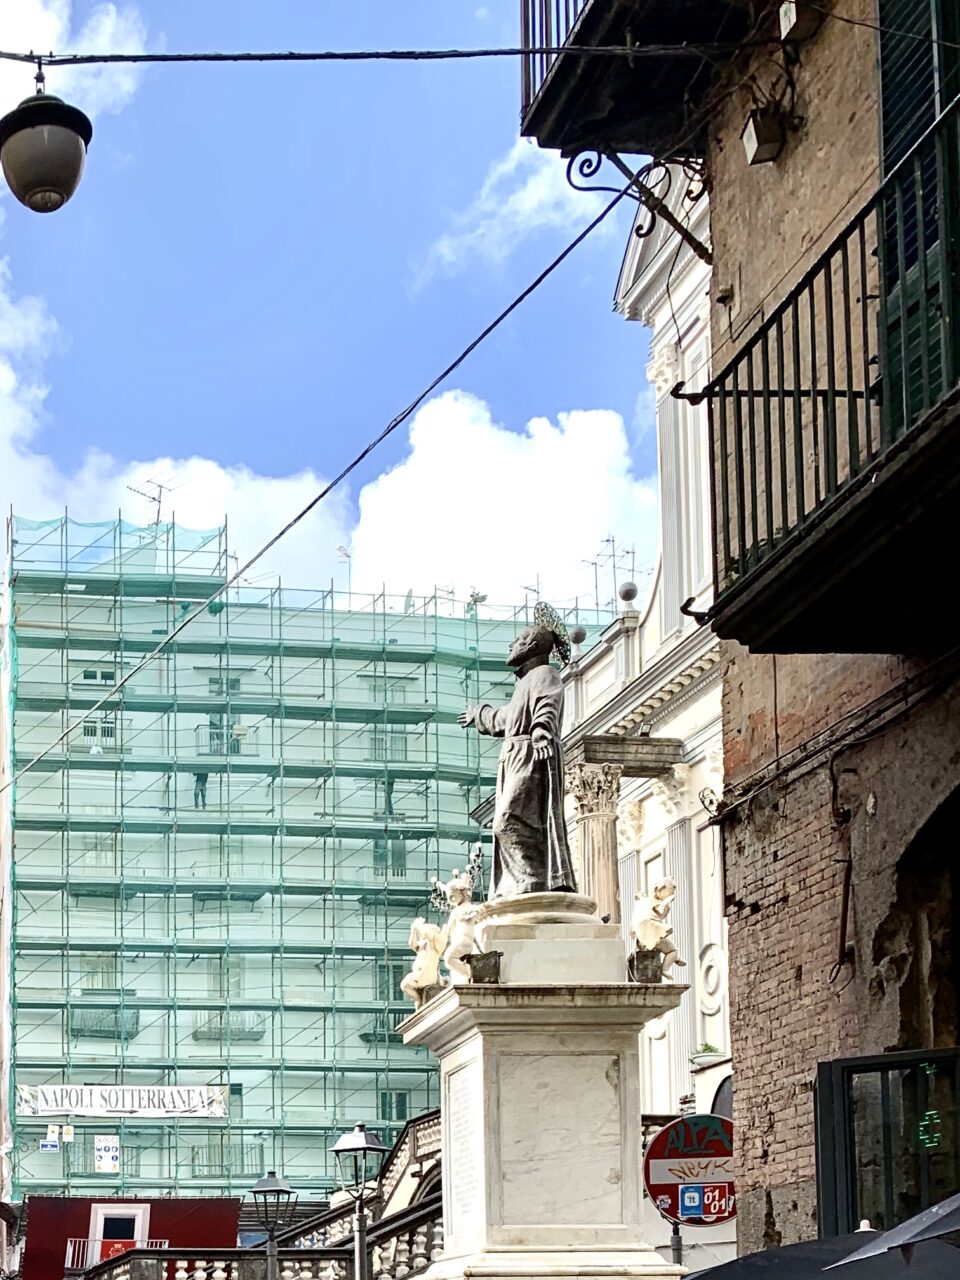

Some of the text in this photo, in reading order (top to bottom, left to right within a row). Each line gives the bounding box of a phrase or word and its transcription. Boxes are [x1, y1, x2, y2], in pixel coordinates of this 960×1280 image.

[40, 1087, 207, 1110] NAPOLI SOTTERRANEA
[704, 1189, 720, 1205] 01
[710, 1197, 726, 1214] 01
